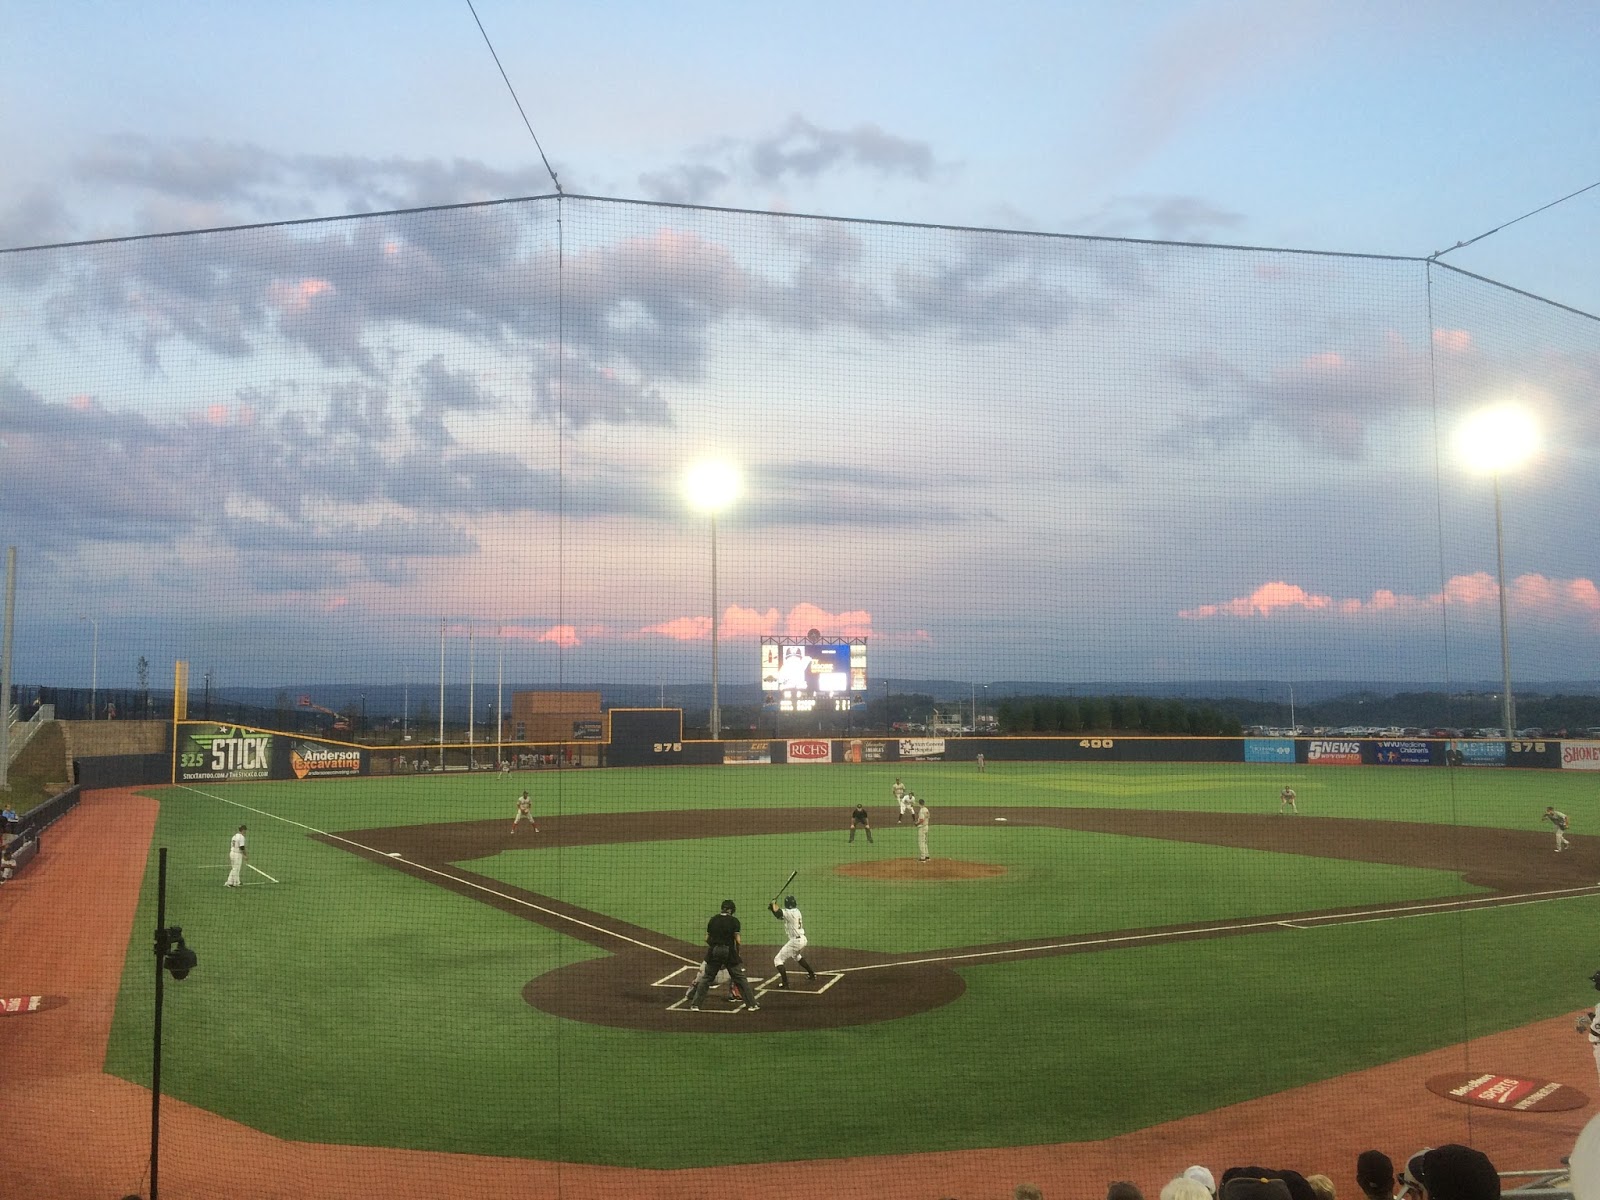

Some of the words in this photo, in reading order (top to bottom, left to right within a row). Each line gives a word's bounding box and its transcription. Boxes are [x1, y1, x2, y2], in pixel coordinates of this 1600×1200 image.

[654, 742, 682, 752] 375
[792, 744, 827, 756] RICH'S
[1080, 740, 1114, 748] 400
[211, 738, 269, 770] STICK
[304, 750, 360, 761] Anderson
[1308, 742, 1323, 760] 5
[1322, 742, 1360, 753] NEWS
[180, 754, 204, 767] 325
[295, 759, 360, 770] Excavating
[1478, 1079, 1518, 1100] SPORTS
